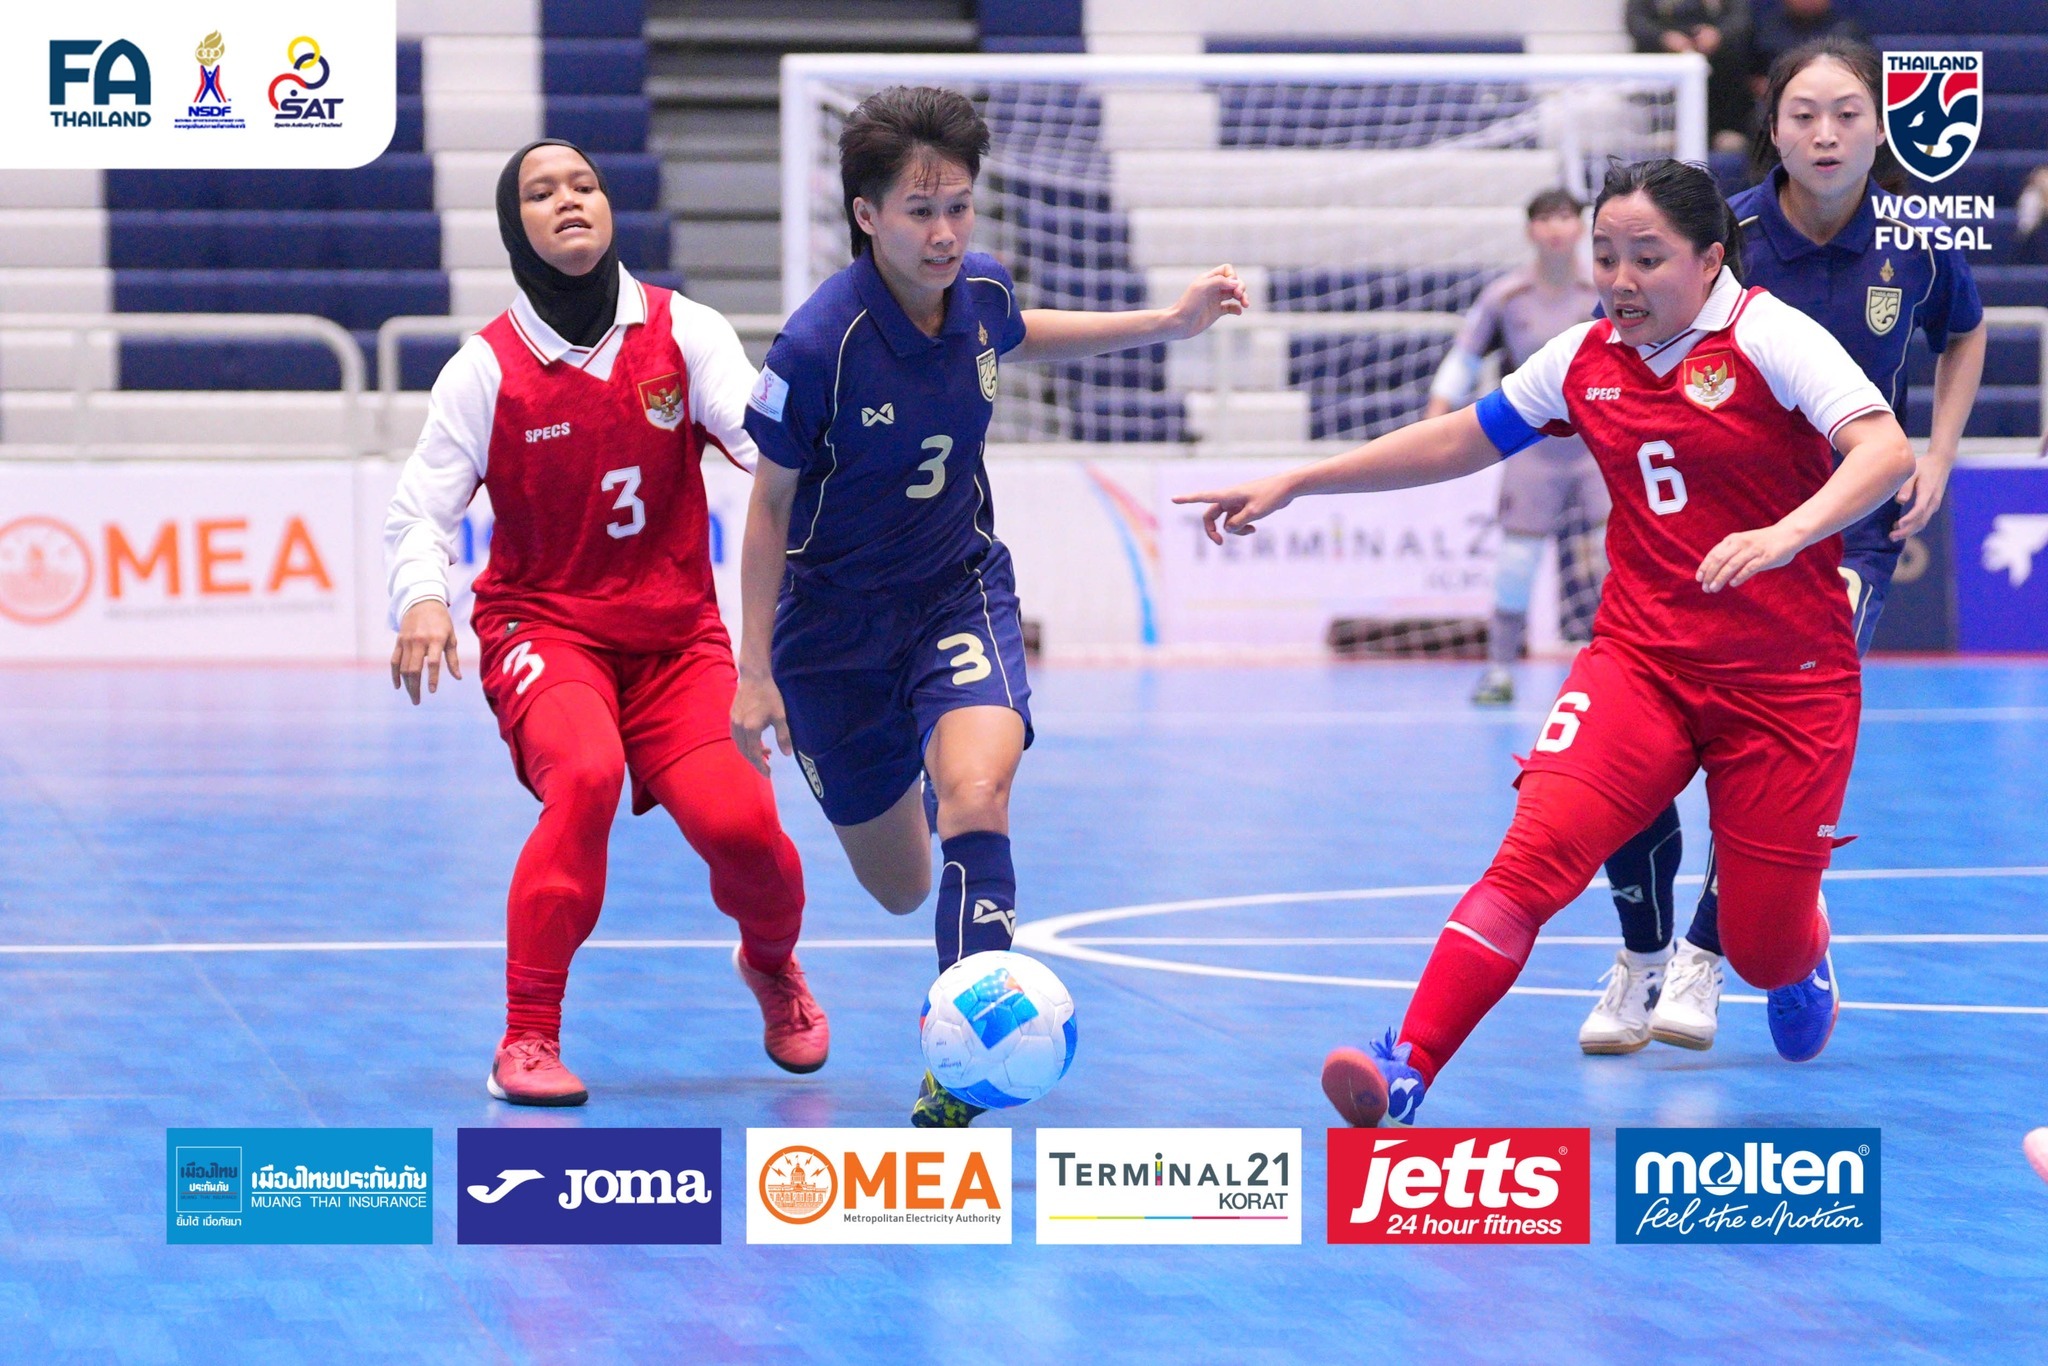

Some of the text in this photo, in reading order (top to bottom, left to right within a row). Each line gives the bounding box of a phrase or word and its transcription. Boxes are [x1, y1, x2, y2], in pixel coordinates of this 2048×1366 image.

[1585, 386, 1622, 401] SPECS
[524, 421, 572, 443] SPECS
[906, 434, 954, 499] 3
[1636, 440, 1688, 516] 6
[600, 465, 646, 540] 3
[105, 516, 334, 599] MEA
[1180, 511, 1498, 564] TERMINAL2
[502, 640, 545, 696] 3
[936, 632, 992, 686] 3
[1536, 691, 1591, 753] 6
